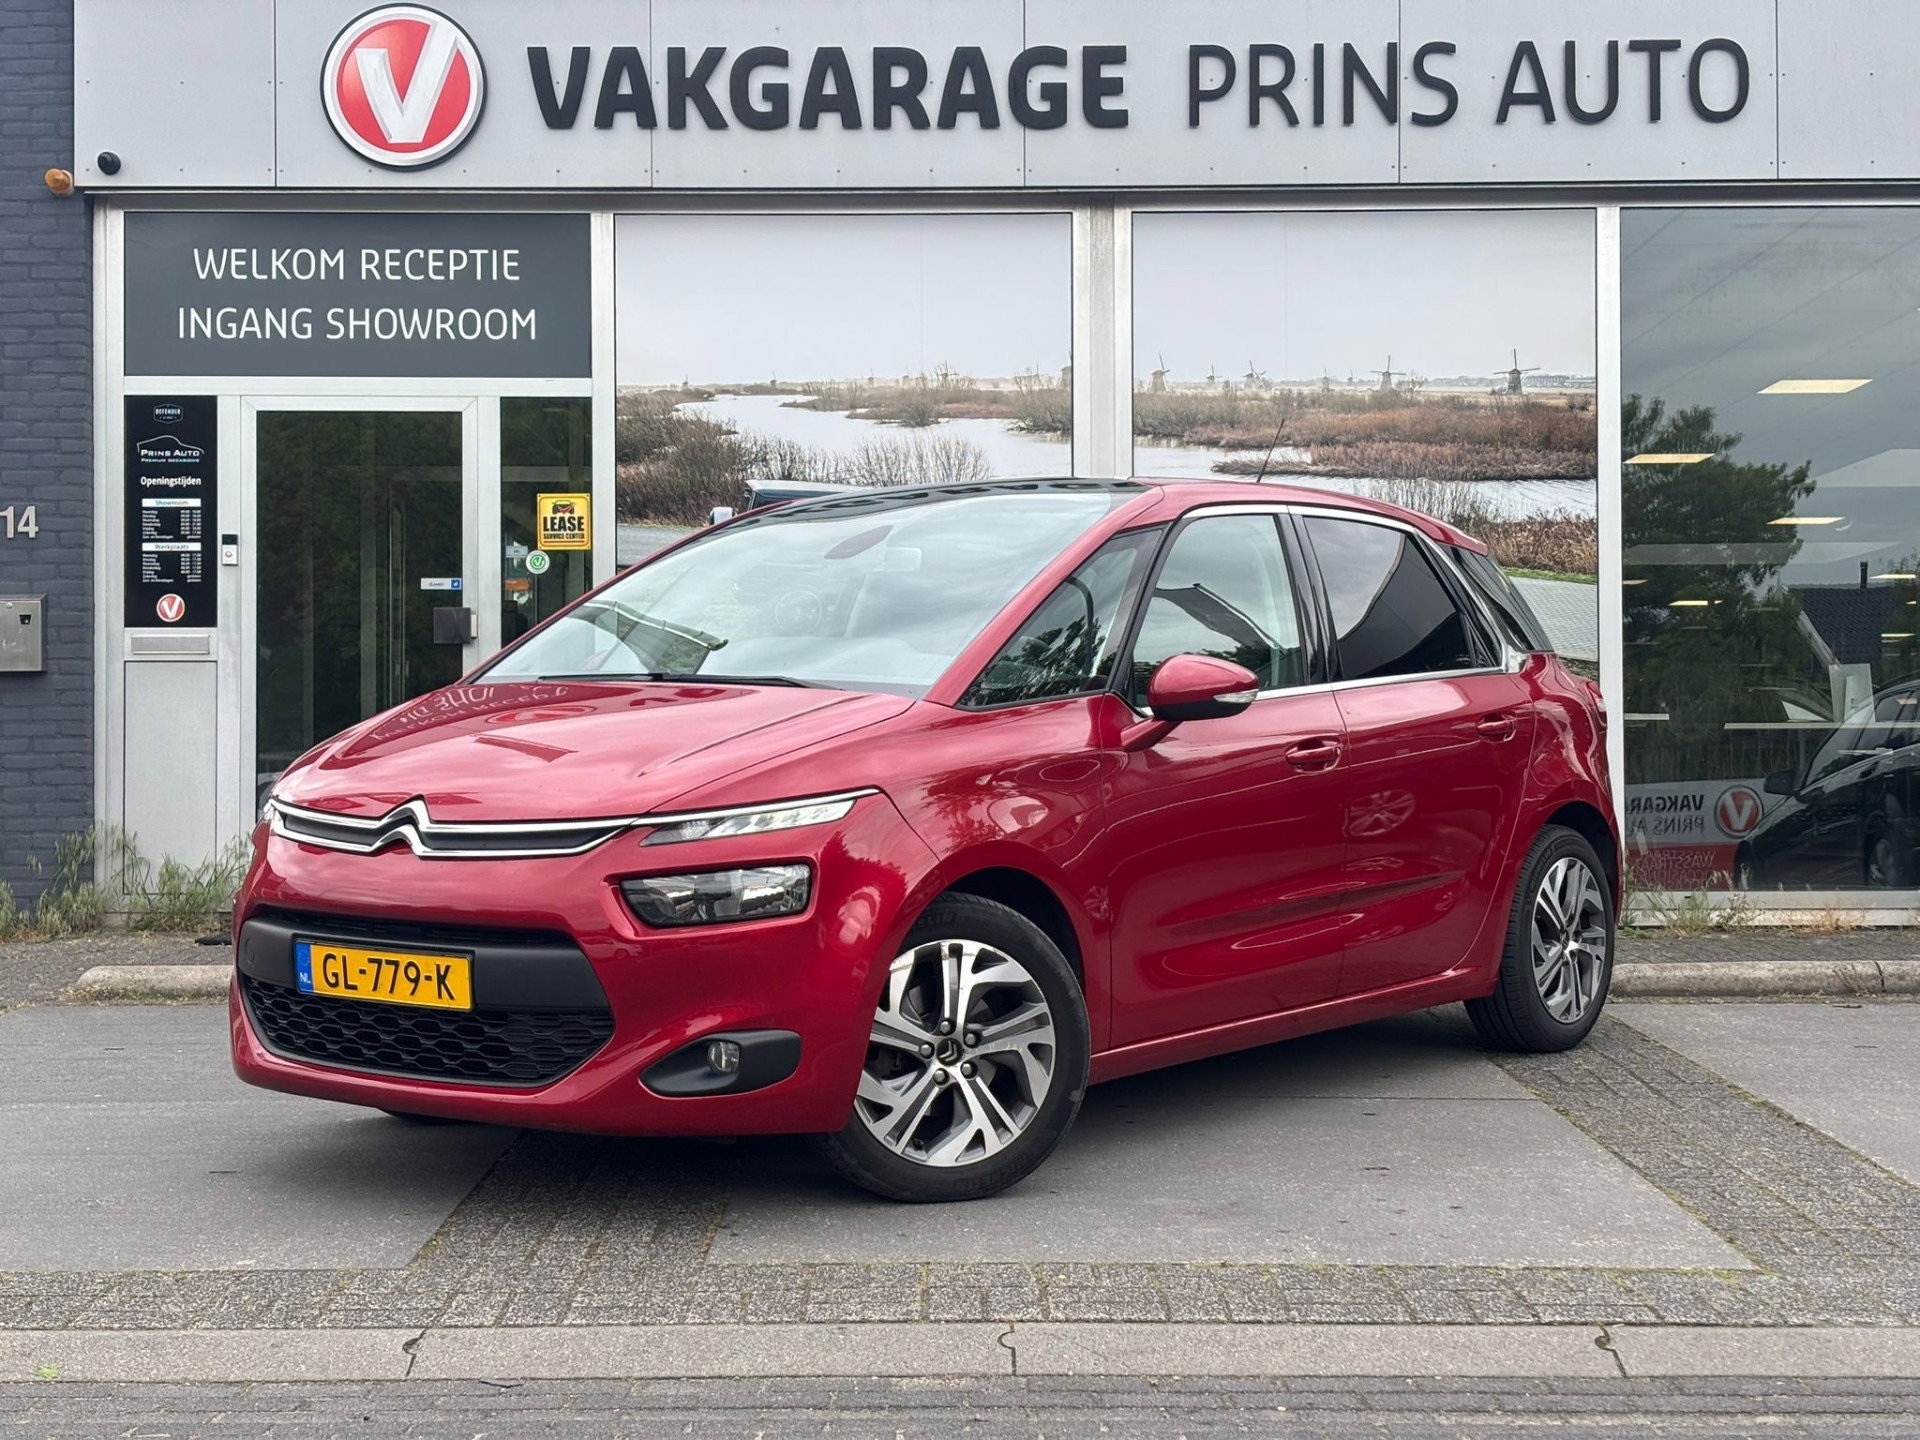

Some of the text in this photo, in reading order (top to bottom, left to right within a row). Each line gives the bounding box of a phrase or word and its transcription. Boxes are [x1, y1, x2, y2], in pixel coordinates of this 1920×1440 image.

[526, 37, 1750, 131] VAKGARAGE PRINS AUTO
[193, 248, 520, 281] WELKOM RECEPTIE
[178, 307, 536, 340] INGANG SHOWROOM
[140, 476, 201, 488] Openingstijden
[0, 505, 39, 539] 14
[543, 516, 585, 532] LEASE
[155, 543, 189, 551] Werkplaats
[565, 532, 585, 540] CENTER
[299, 971, 311, 984] NL
[322, 953, 456, 1000] GL-779-K
